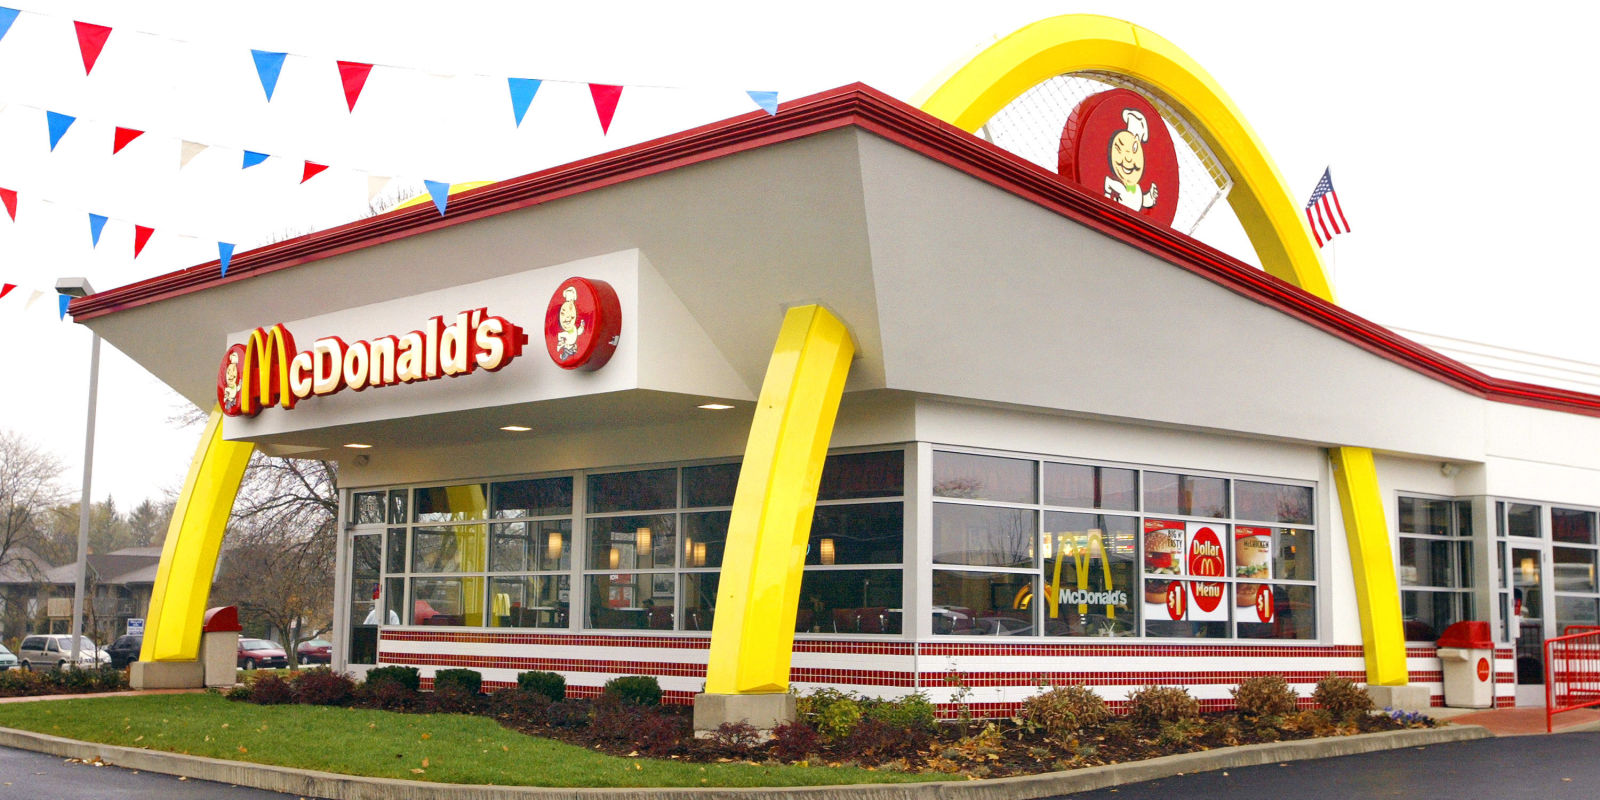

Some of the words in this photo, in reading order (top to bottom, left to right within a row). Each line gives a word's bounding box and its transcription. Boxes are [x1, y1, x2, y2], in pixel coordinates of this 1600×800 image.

[240, 308, 503, 415] McDonald's
[1193, 539, 1220, 557] Dollar
[1059, 588, 1128, 605] McDonald's
[1168, 585, 1182, 616] $1
[1195, 582, 1220, 598] Menu
[1257, 589, 1270, 618] $1
